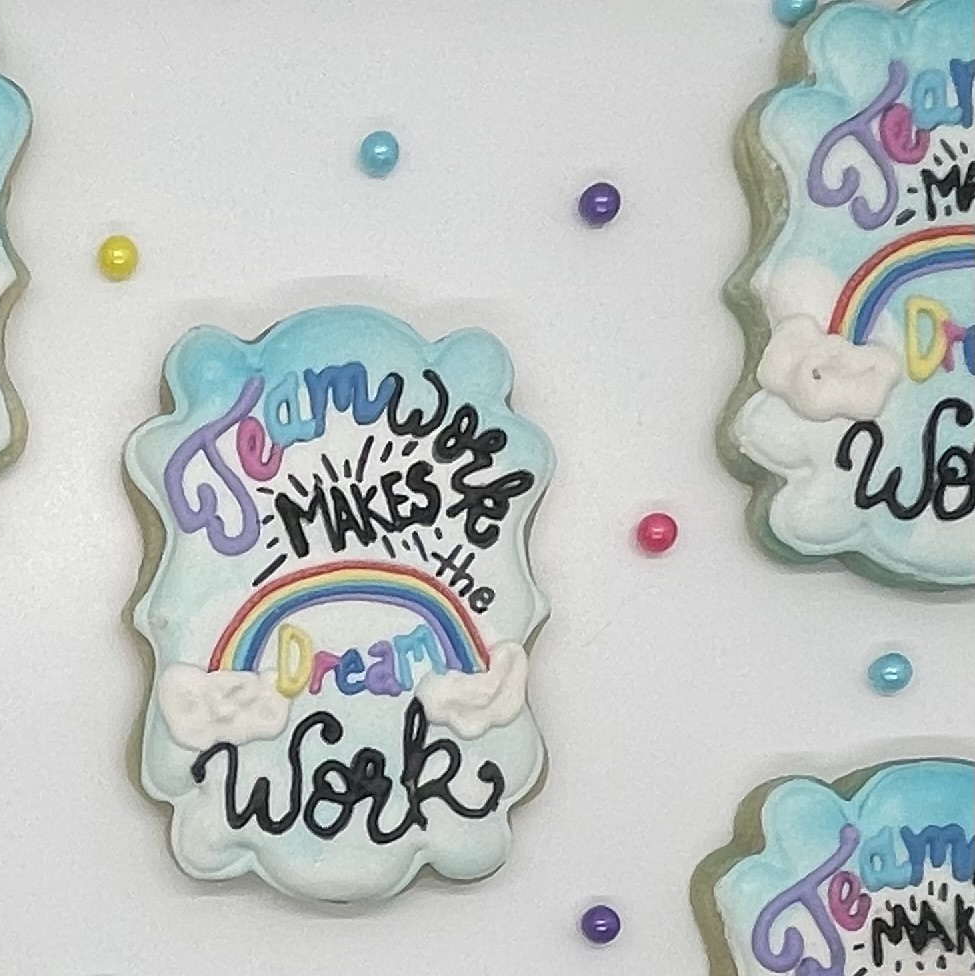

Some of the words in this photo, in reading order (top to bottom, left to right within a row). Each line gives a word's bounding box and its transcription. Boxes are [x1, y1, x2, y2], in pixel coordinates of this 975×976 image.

[274, 461, 443, 558] MAKES
[432, 544, 496, 614] the
[276, 623, 449, 698] Dream
[191, 697, 504, 844] Work
